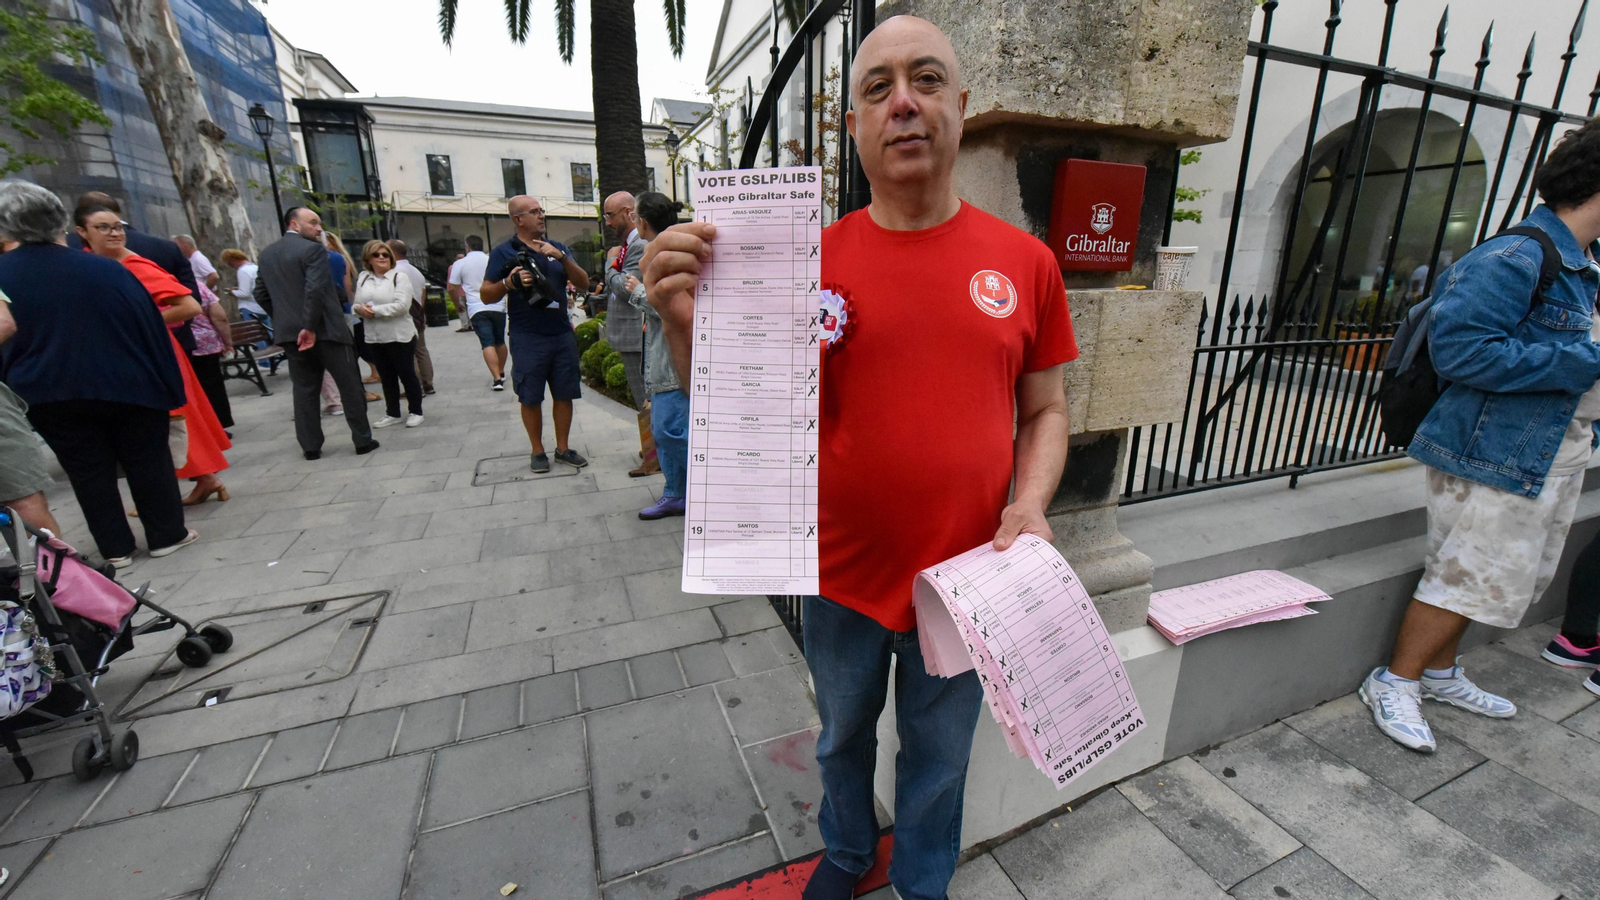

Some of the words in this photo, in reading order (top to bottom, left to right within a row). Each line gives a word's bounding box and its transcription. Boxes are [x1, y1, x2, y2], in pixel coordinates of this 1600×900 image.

[698, 176, 736, 188] VOTE
[740, 172, 816, 186] GSLP/LIBS
[698, 194, 734, 204] ...Keep
[738, 192, 786, 201] Gibraltar
[790, 190, 815, 199] Safe
[1066, 234, 1131, 253] Gibraltar
[1065, 254, 1111, 262] INTERNATIONAL
[694, 454, 705, 462] 15
[692, 526, 703, 535] 19
[1053, 560, 1062, 569] 11
[1062, 574, 1072, 584] 10
[1114, 718, 1144, 742] VOTE
[1074, 728, 1109, 756] Gibraltar
[1054, 755, 1072, 770] Safe
[1058, 740, 1112, 784] GSLP/LIBS
